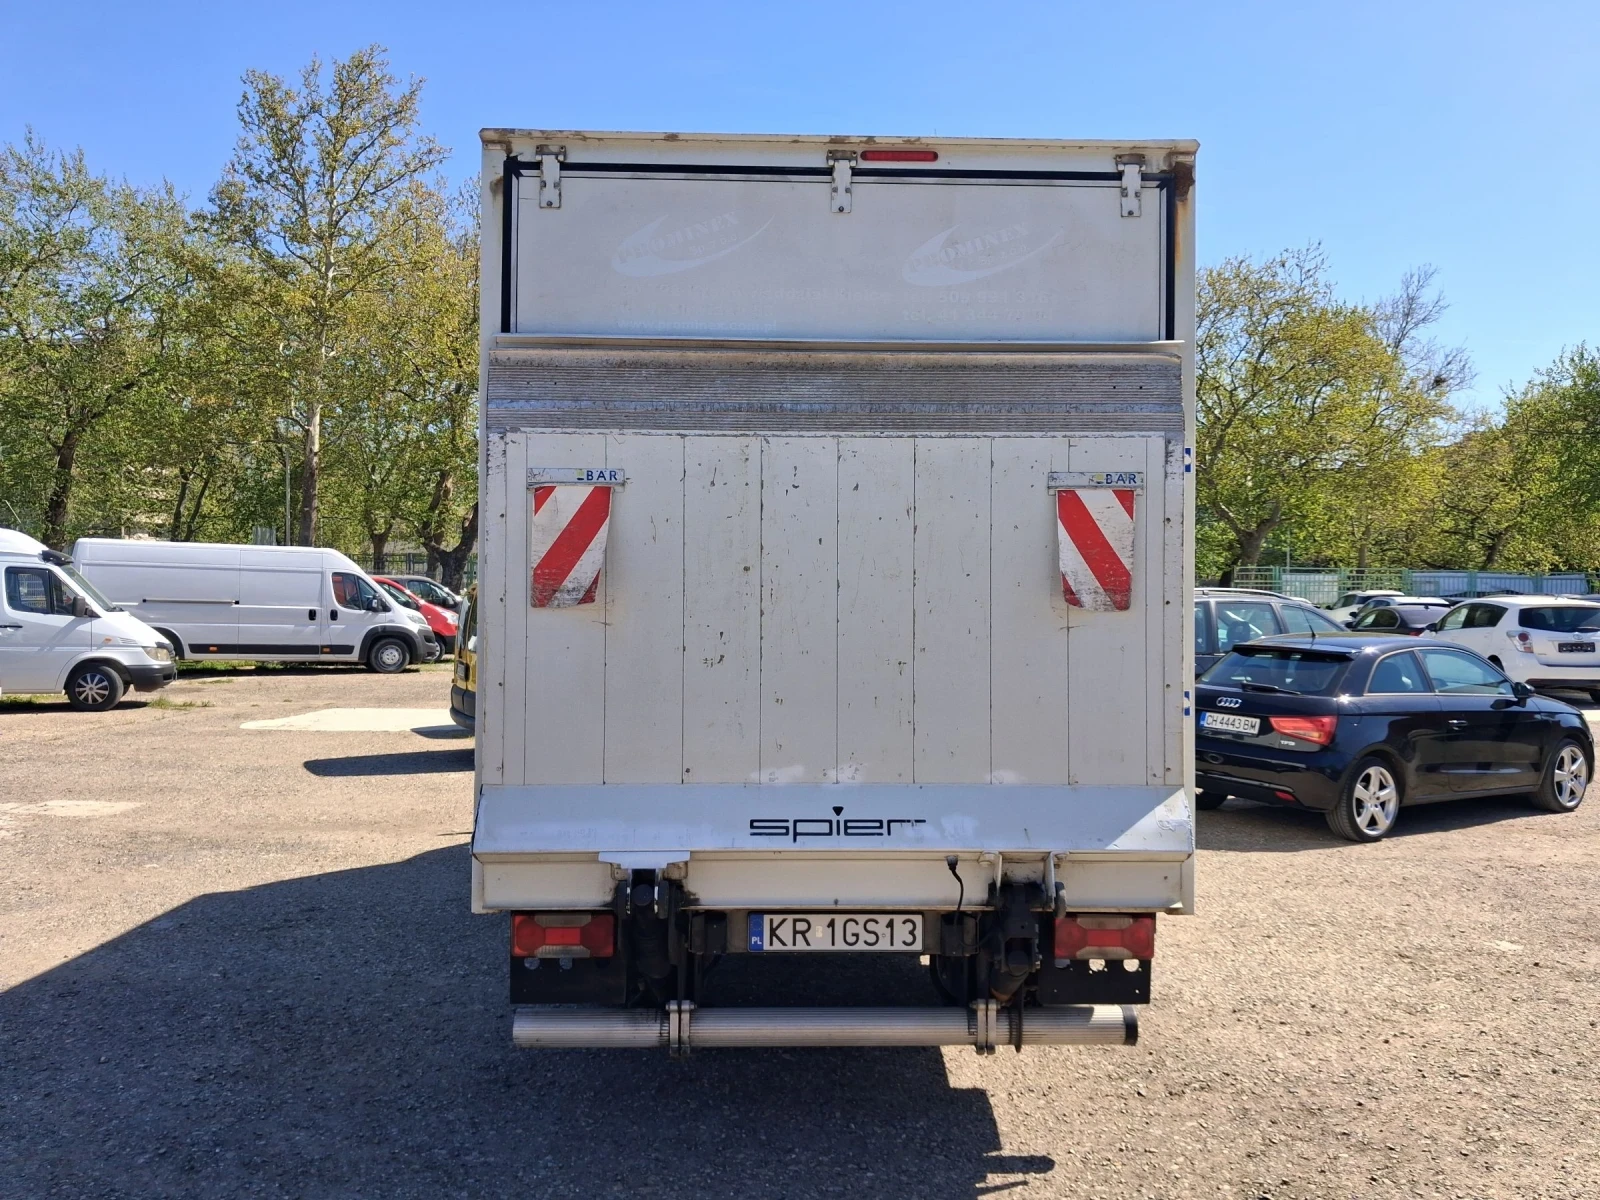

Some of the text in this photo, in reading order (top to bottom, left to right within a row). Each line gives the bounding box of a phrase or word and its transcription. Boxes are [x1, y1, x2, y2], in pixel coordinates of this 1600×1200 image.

[909, 221, 1029, 272] PROMINEX
[1206, 715, 1257, 731] CH 4443 BM
[749, 806, 926, 844] spier
[751, 918, 917, 947] PL KR 1GS13
